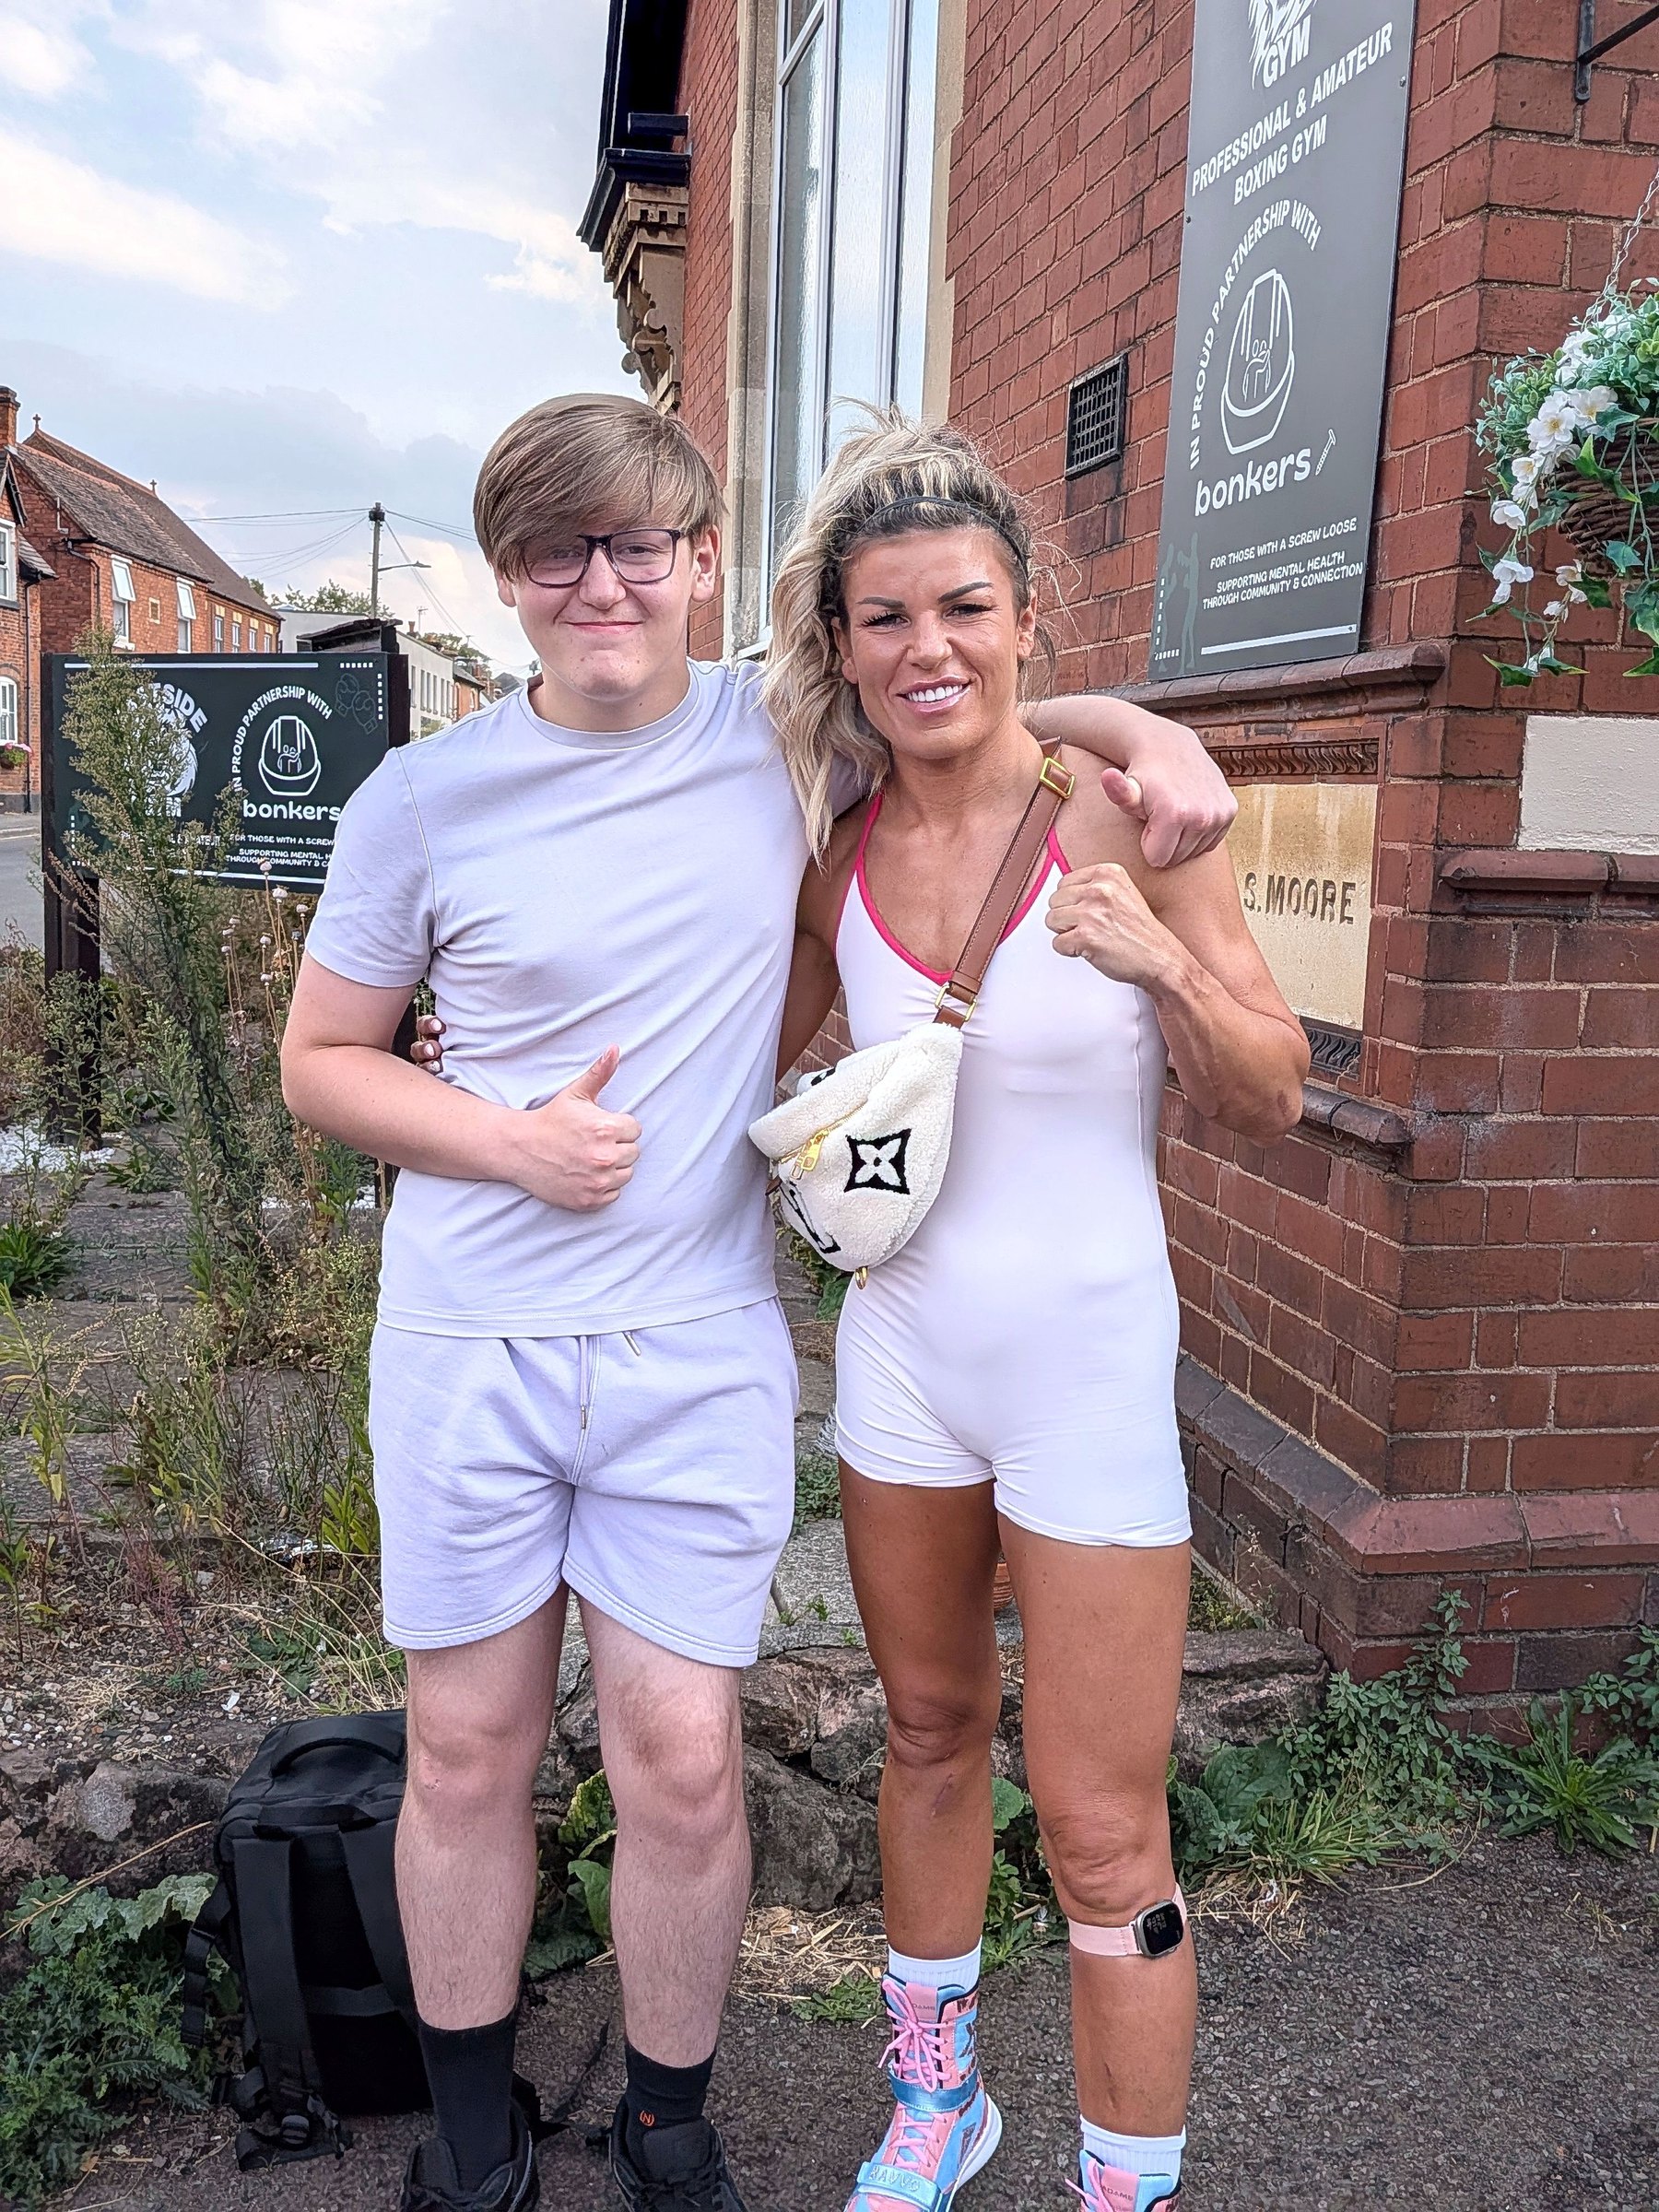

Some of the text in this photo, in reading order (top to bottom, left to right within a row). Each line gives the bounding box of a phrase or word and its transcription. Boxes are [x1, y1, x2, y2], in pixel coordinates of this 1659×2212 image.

[1263, 15, 1311, 88] GYM
[1192, 21, 1393, 196] PROFESSIONAL & AMATEUR
[1233, 113, 1327, 206] BOXING GYM
[1190, 199, 1322, 470] IN PROUD PARTNERSHIP WITH
[1194, 448, 1312, 516] bonkers
[1210, 517, 1357, 570] FOR THOSE WITH A SCREW LOOSE
[1217, 550, 1346, 593] SUPPORTING MENTAL HEALTH
[1203, 561, 1364, 609] THROUGH COMMUNITY & CONNECTION
[231, 685, 333, 792] IN PROUD PARTNERSHIP WITH
[242, 799, 341, 821] bonkers
[247, 834, 275, 843] THOSE
[276, 835, 296, 844] WITH
[298, 837, 304, 845] A
[239, 848, 288, 858] SUPPORTING
[290, 851, 324, 860] MENTAL
